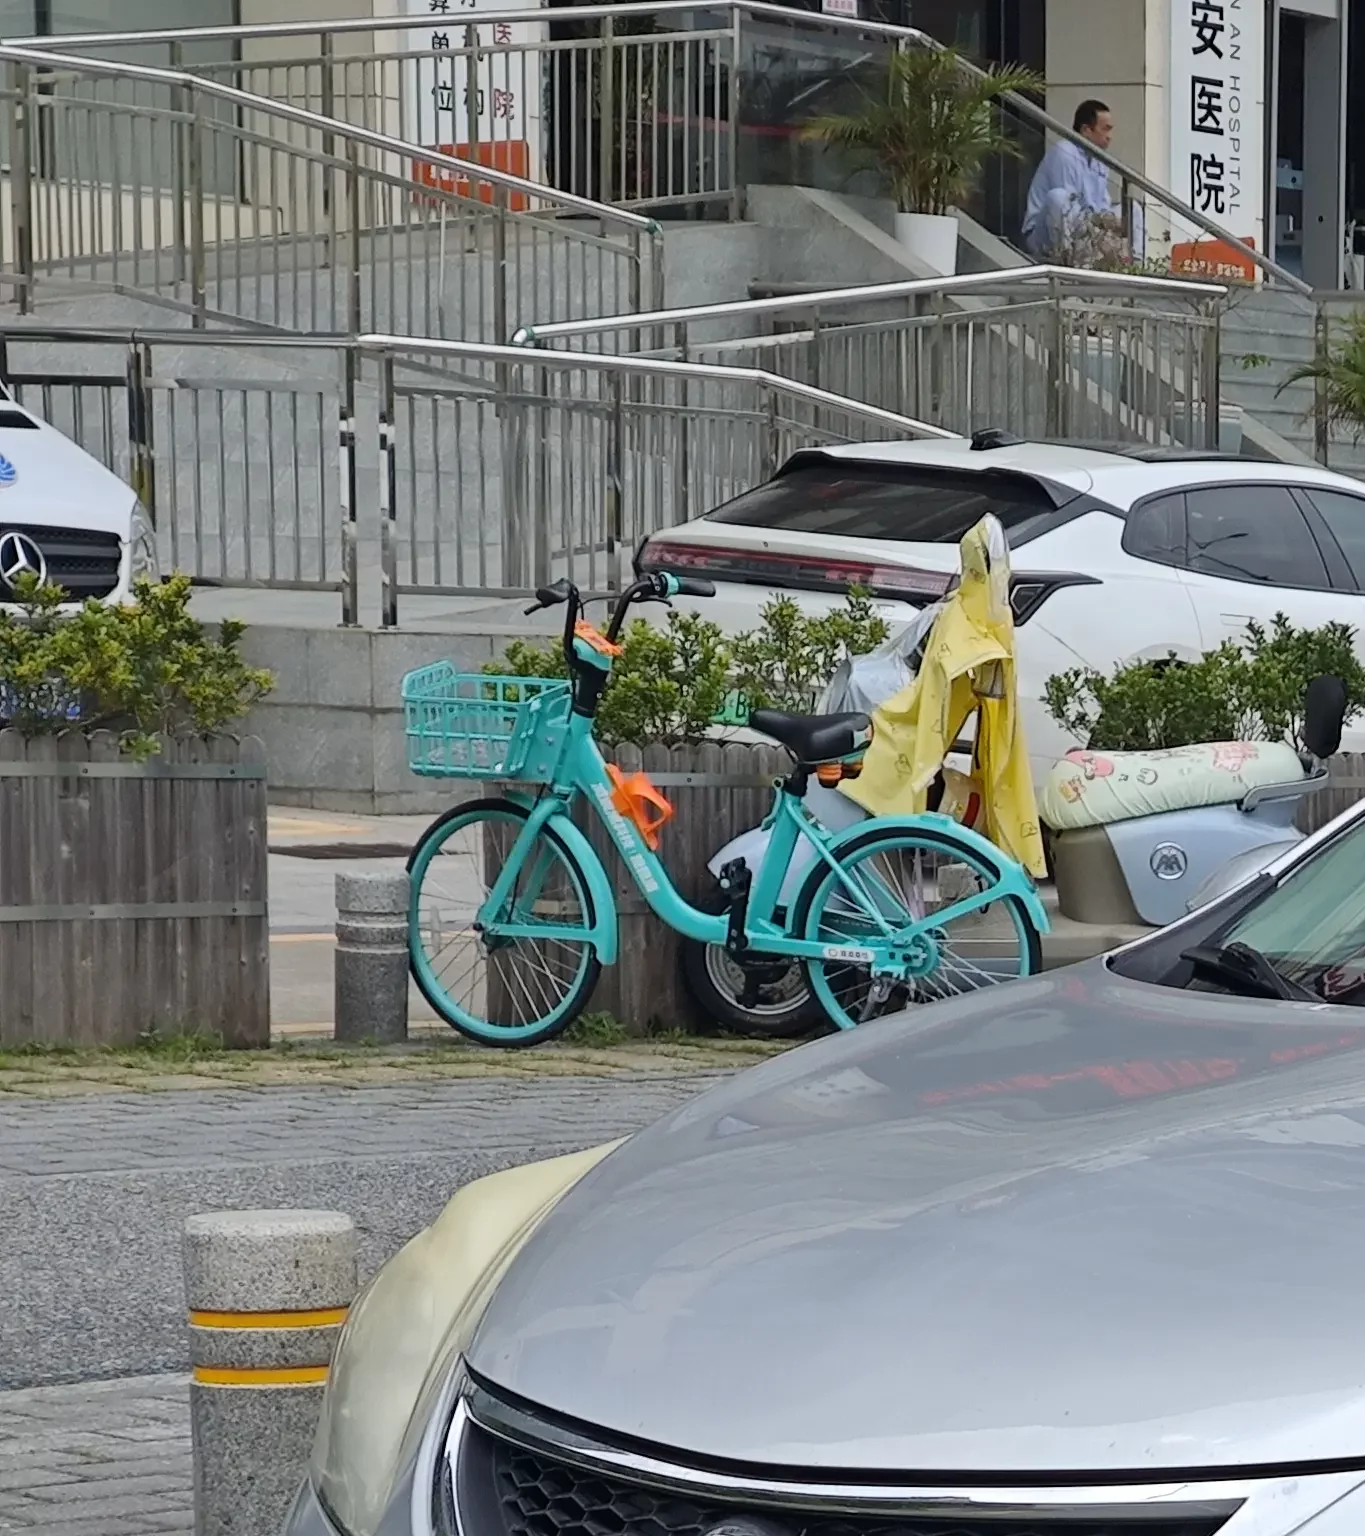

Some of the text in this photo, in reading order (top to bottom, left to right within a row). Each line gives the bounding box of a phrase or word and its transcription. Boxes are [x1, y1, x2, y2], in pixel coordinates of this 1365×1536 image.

[1191, 0, 1225, 214] 安医院
[1228, 75, 1241, 215] HOSPITAL
